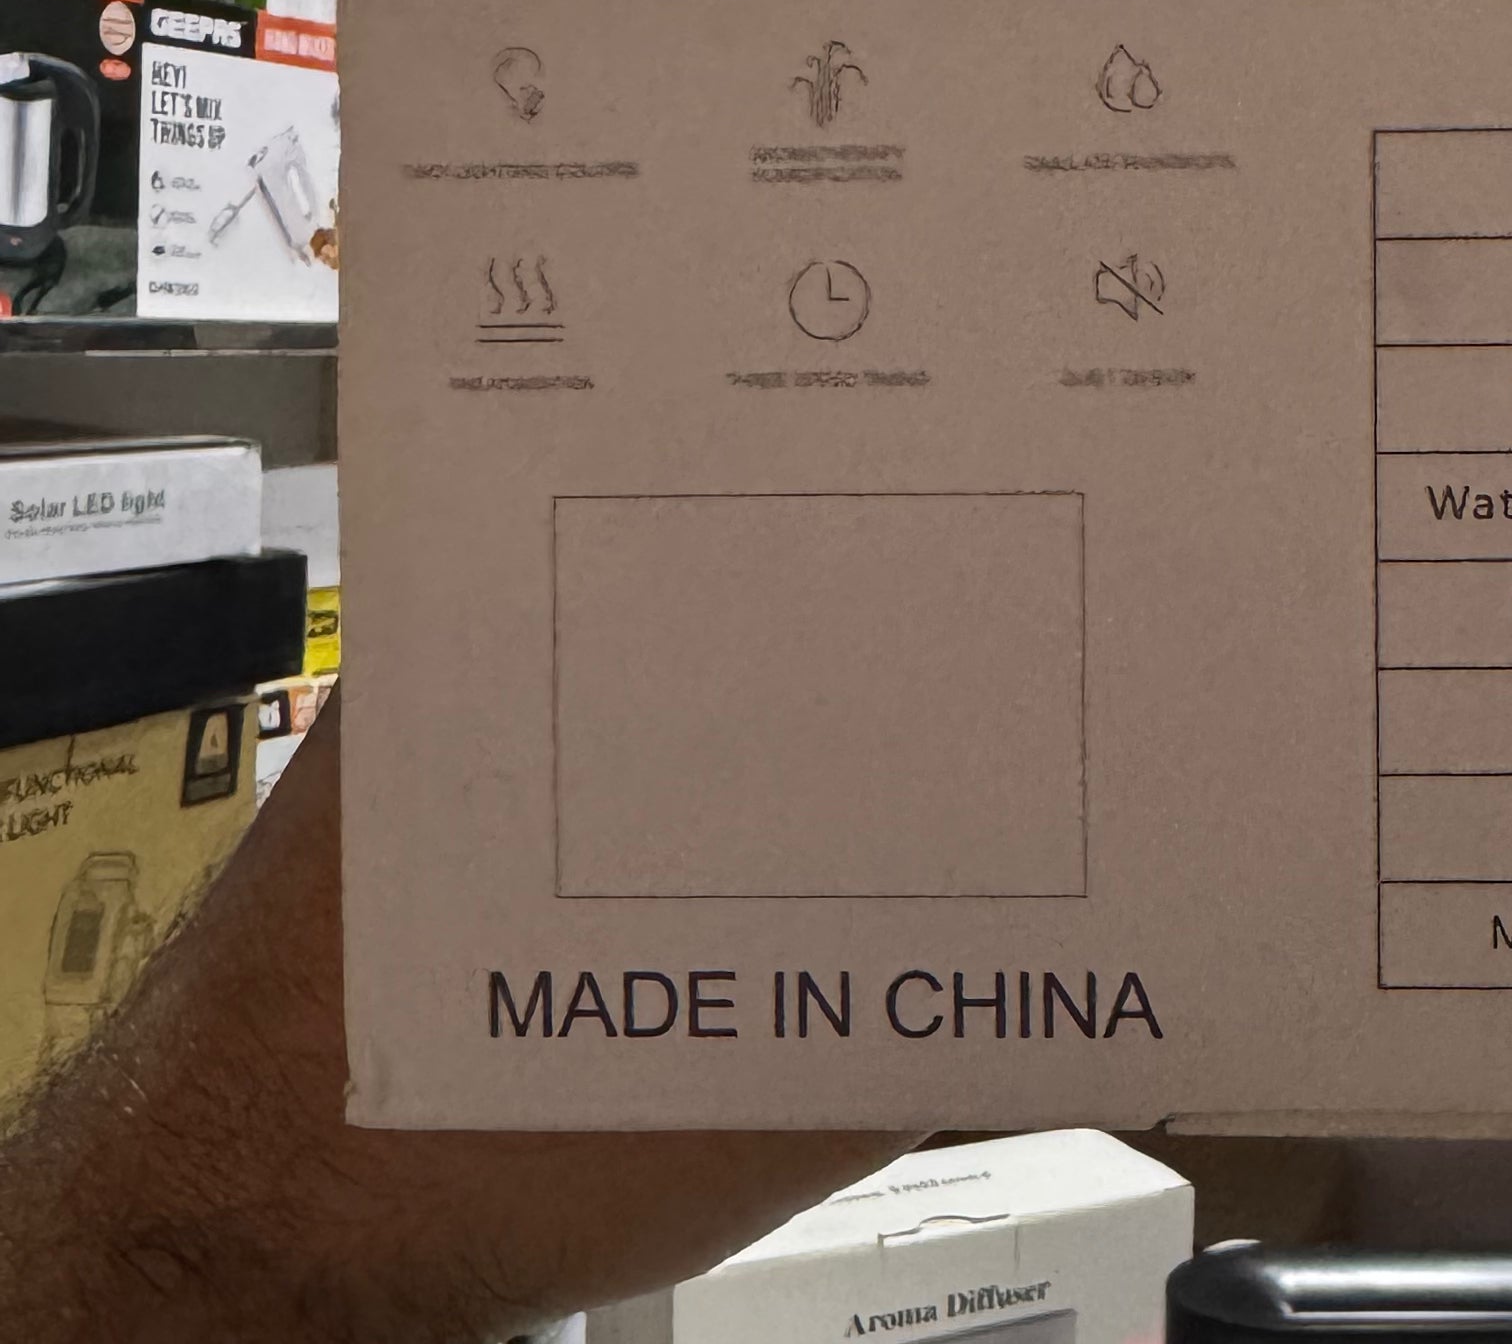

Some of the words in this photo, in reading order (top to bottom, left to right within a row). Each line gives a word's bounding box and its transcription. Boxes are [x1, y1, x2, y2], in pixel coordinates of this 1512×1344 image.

[150, 8, 242, 48] GEEPAS
[151, 90, 193, 118] LET'S
[150, 118, 206, 149] THINGS
[9, 497, 67, 524] Solar
[72, 491, 116, 518] LED
[487, 969, 739, 1040] MADE
[773, 969, 852, 1040] IN
[884, 969, 1165, 1040] CHINA
[843, 1304, 939, 1338] Aroma
[946, 1279, 1052, 1318] Diffuser
